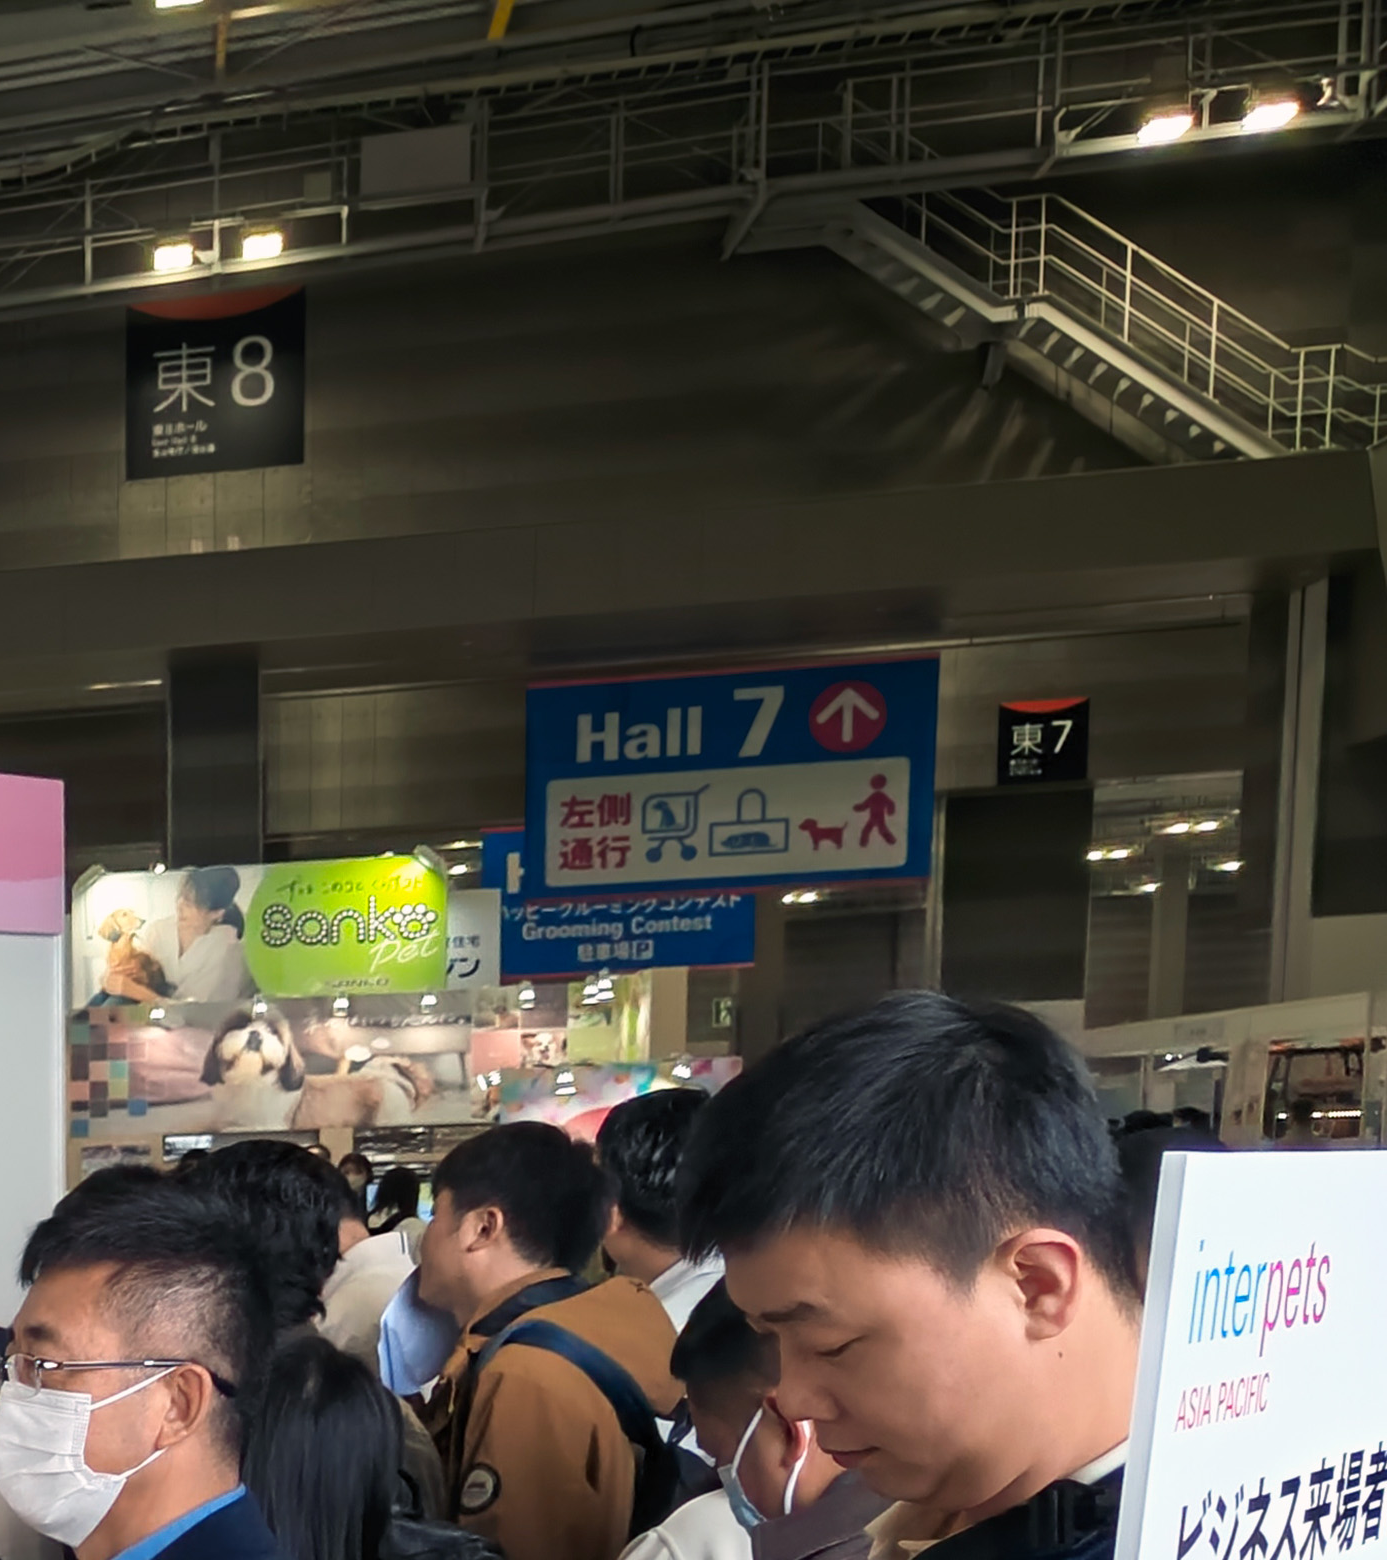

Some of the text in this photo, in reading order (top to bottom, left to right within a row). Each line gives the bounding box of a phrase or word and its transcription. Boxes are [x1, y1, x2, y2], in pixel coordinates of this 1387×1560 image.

[152, 335, 275, 412] 東8
[575, 685, 785, 763] Hall 7
[1010, 719, 1073, 755] 東7
[559, 793, 632, 829] 左側
[558, 835, 632, 872] 通行
[522, 914, 712, 941] Grooming Contest
[1188, 1240, 1331, 1358] interpets
[1175, 1372, 1270, 1432] ASIA PACIFIC
